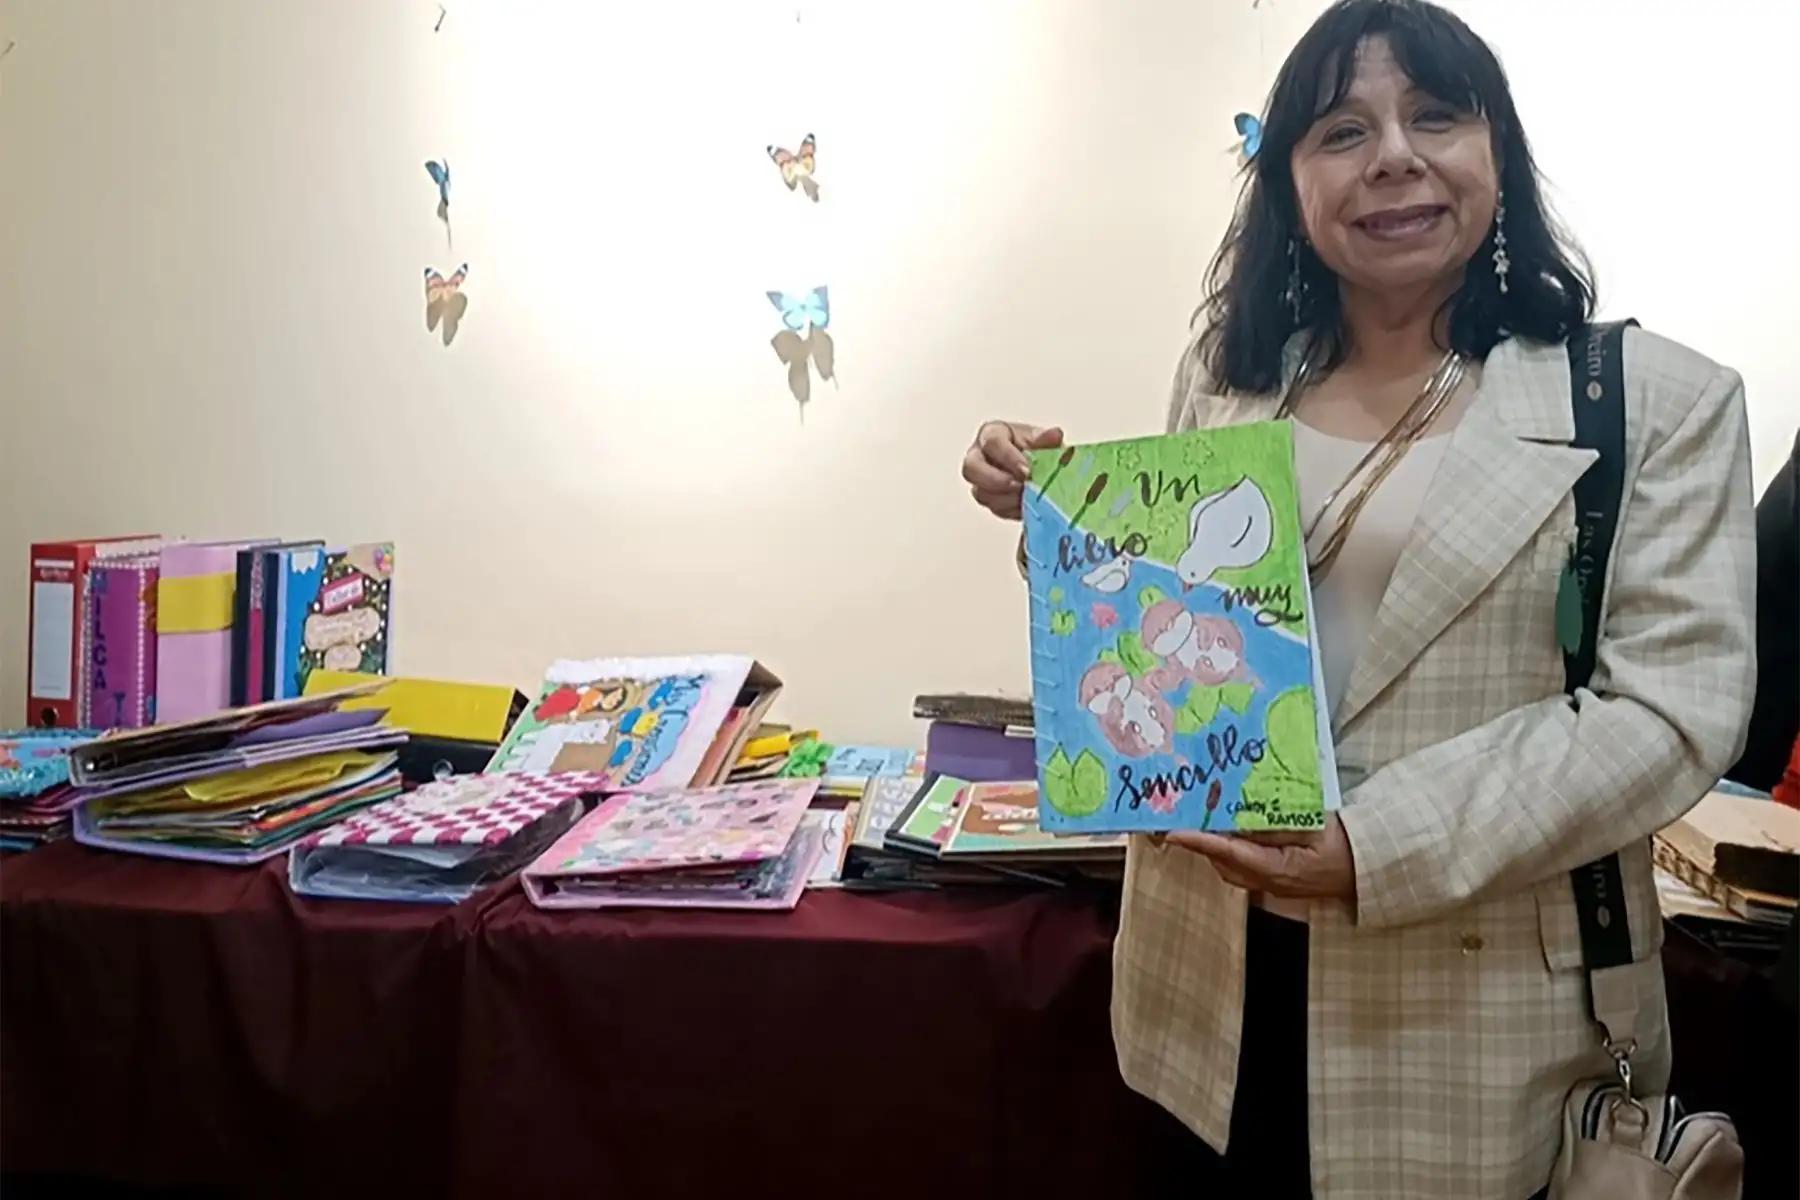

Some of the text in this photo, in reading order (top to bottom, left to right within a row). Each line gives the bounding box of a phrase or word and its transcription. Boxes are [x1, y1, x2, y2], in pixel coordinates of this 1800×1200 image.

[1053, 525, 1149, 577] libro
[1218, 583, 1303, 626] muy
[1267, 812, 1315, 826] RAMOS
